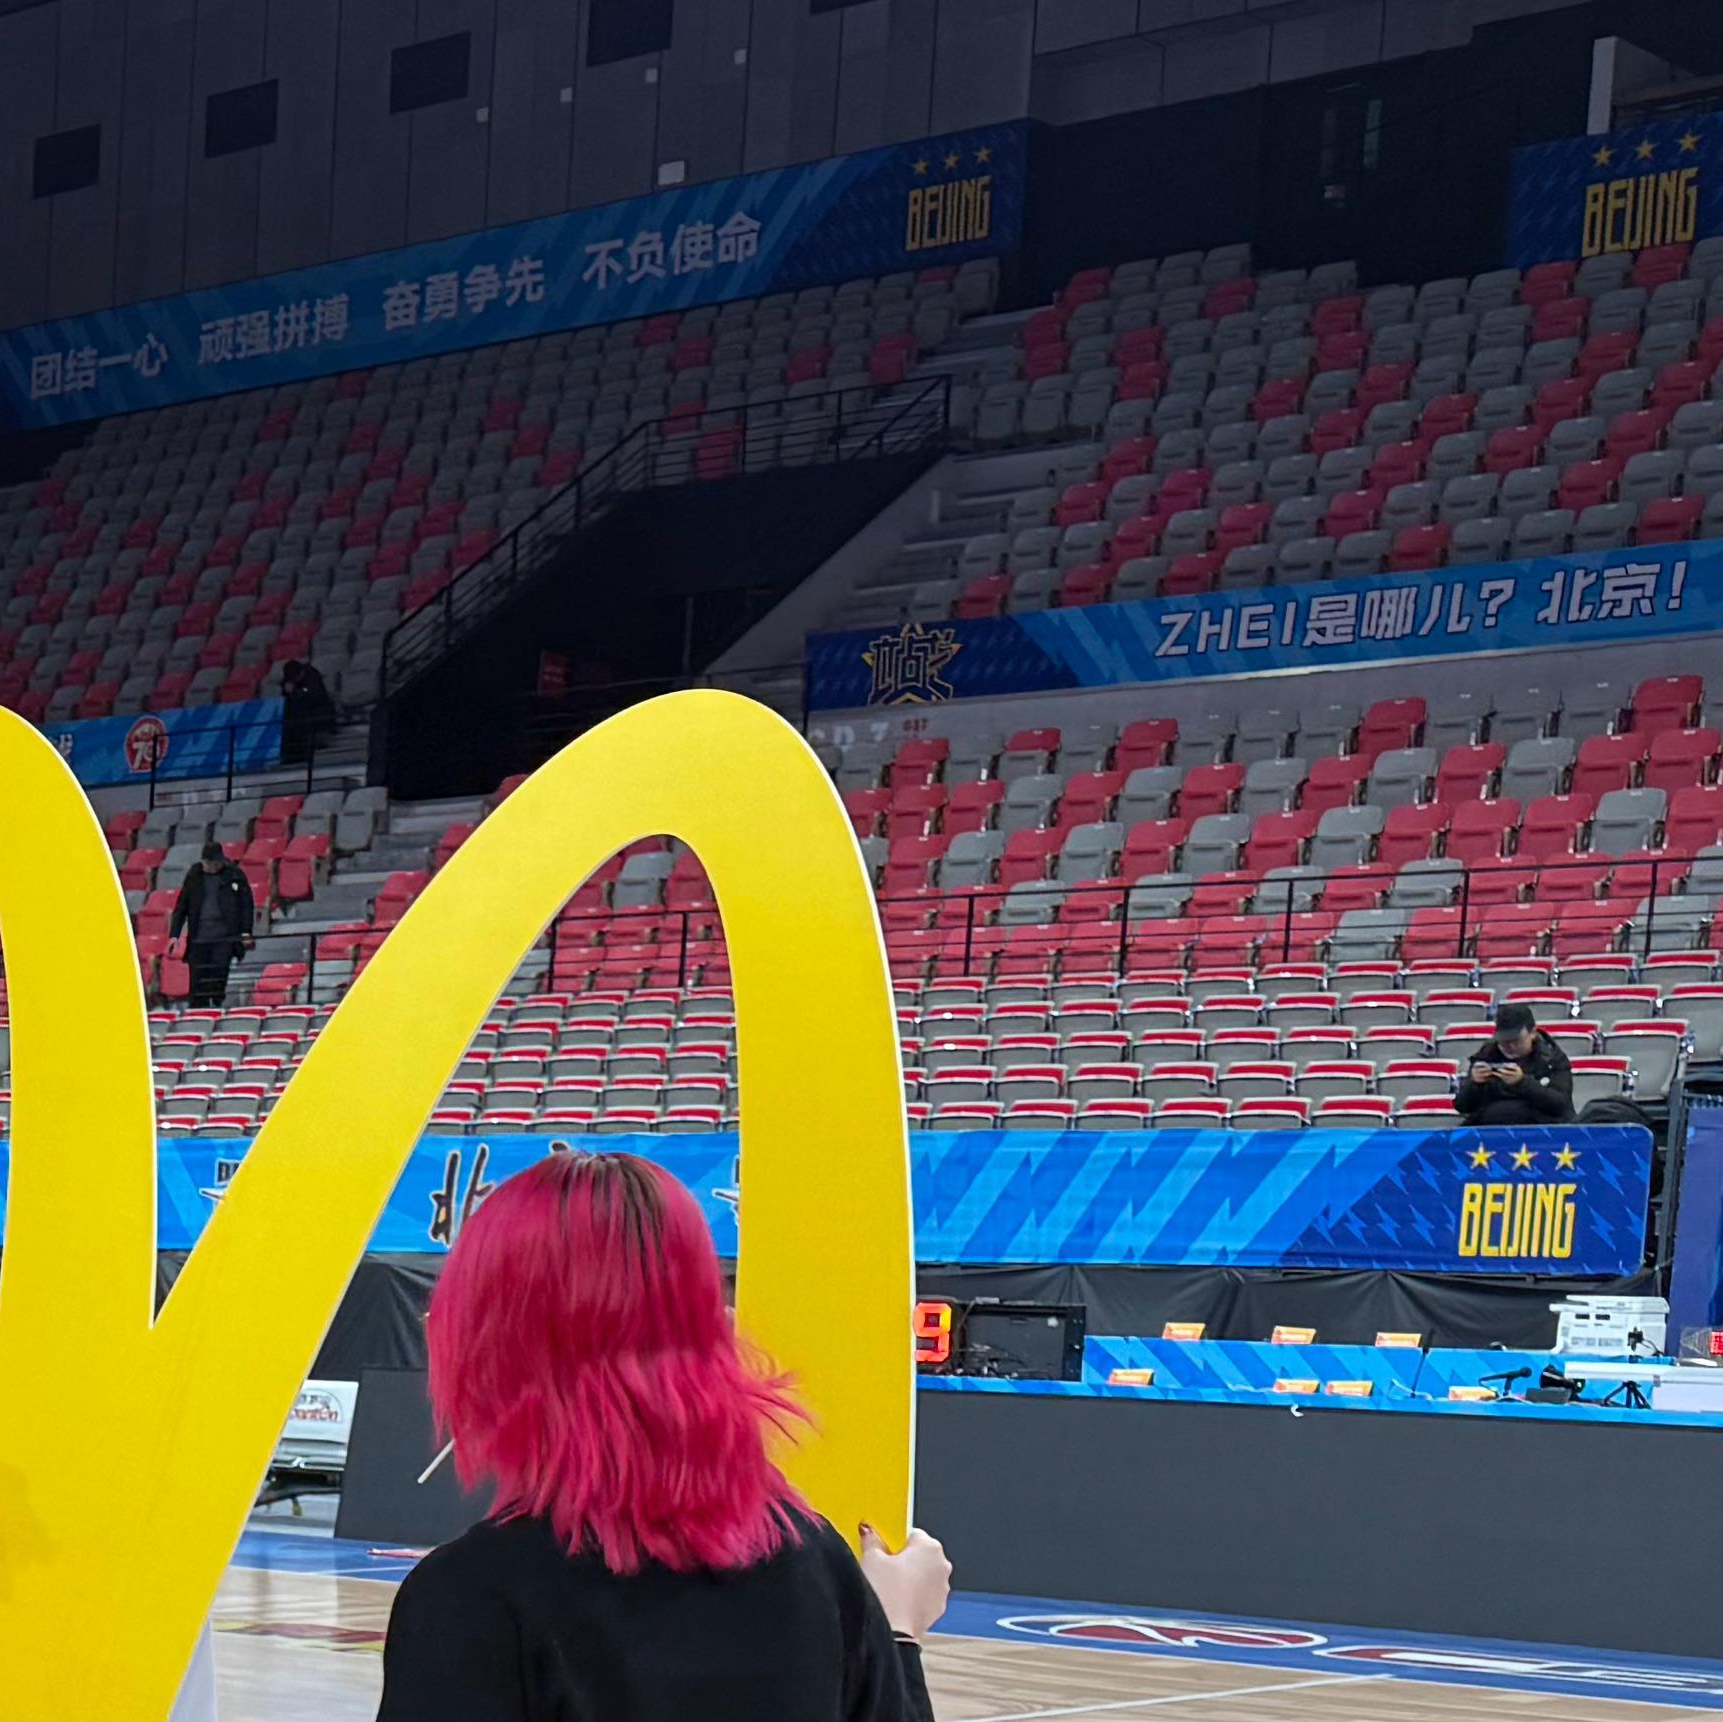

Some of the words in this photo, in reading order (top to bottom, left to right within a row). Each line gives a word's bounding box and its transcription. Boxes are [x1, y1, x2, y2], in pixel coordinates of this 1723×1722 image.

[904, 174, 993, 252] BEIJING
[1581, 167, 1700, 258] BEIJING
[30, 334, 169, 400] 团结一心
[198, 293, 350, 366] 顽强拼搏
[382, 256, 545, 330] 奋勇争先
[582, 212, 762, 290] 不负使命
[1457, 1182, 1575, 1259] BEIJING
